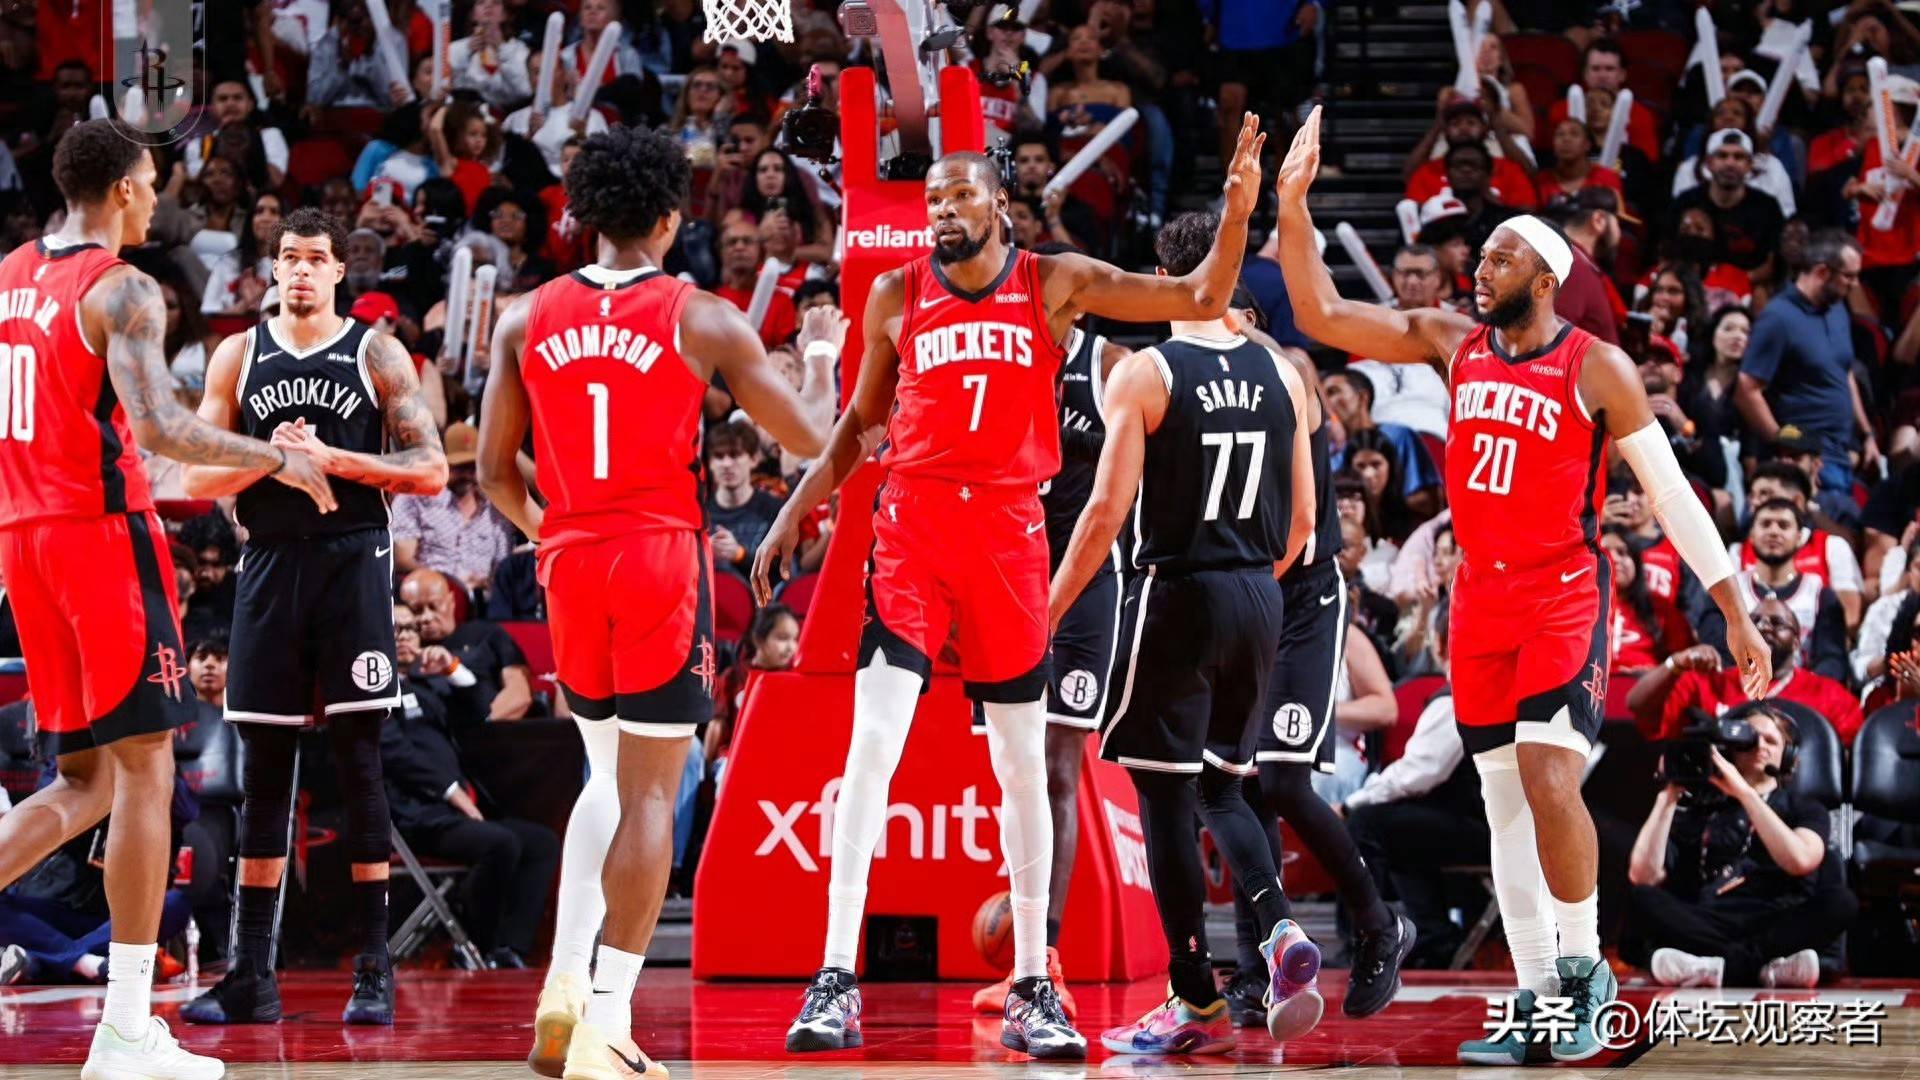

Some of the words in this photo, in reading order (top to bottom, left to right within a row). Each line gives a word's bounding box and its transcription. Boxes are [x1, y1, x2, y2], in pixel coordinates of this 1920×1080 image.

[847, 224, 937, 248] reliant
[33, 295, 60, 337] JR.
[534, 324, 664, 375] THOMPSON
[915, 321, 1033, 375] ROCKETS
[249, 377, 362, 421] BROOKLYN
[962, 374, 988, 432] 7
[1195, 379, 1264, 413] SARAF
[1455, 381, 1562, 442] ROCKETS
[587, 382, 609, 480] 1
[1201, 431, 1266, 521] 77
[1467, 433, 1517, 496] 20
[755, 776, 1012, 877] xfnit
